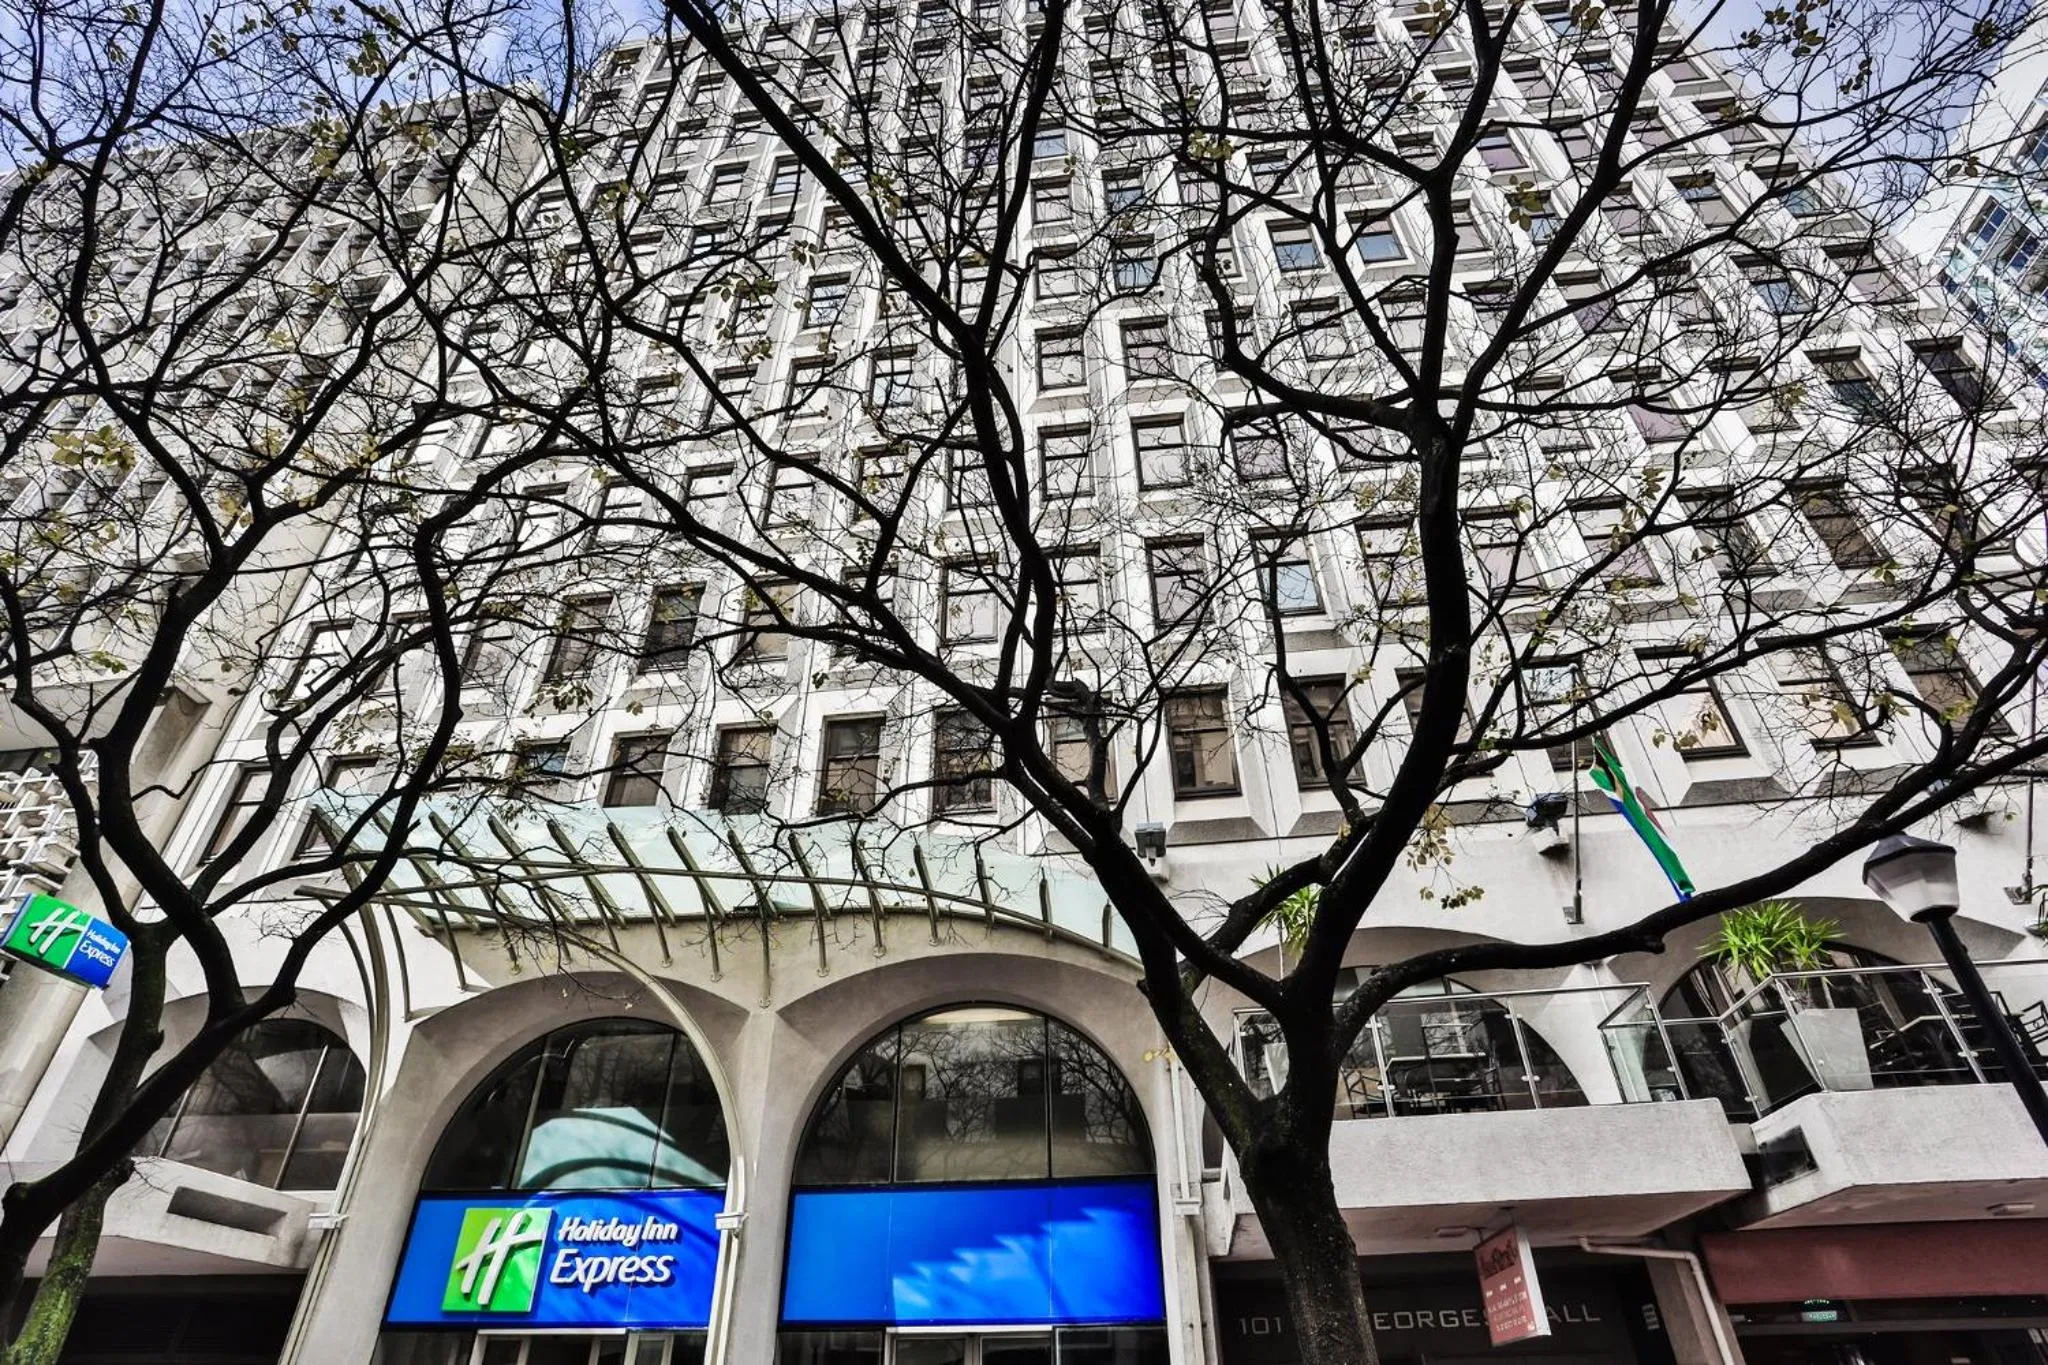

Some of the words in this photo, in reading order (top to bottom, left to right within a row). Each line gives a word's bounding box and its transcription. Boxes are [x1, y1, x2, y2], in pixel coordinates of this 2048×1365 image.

[79, 940, 116, 967] Express
[558, 1216, 642, 1247] Holiday
[642, 1215, 679, 1240] Inn
[550, 1248, 674, 1293] Express
[1239, 1316, 1283, 1335] 101
[1373, 1307, 1489, 1331] EORGE
[1546, 1303, 1602, 1324] ALL
